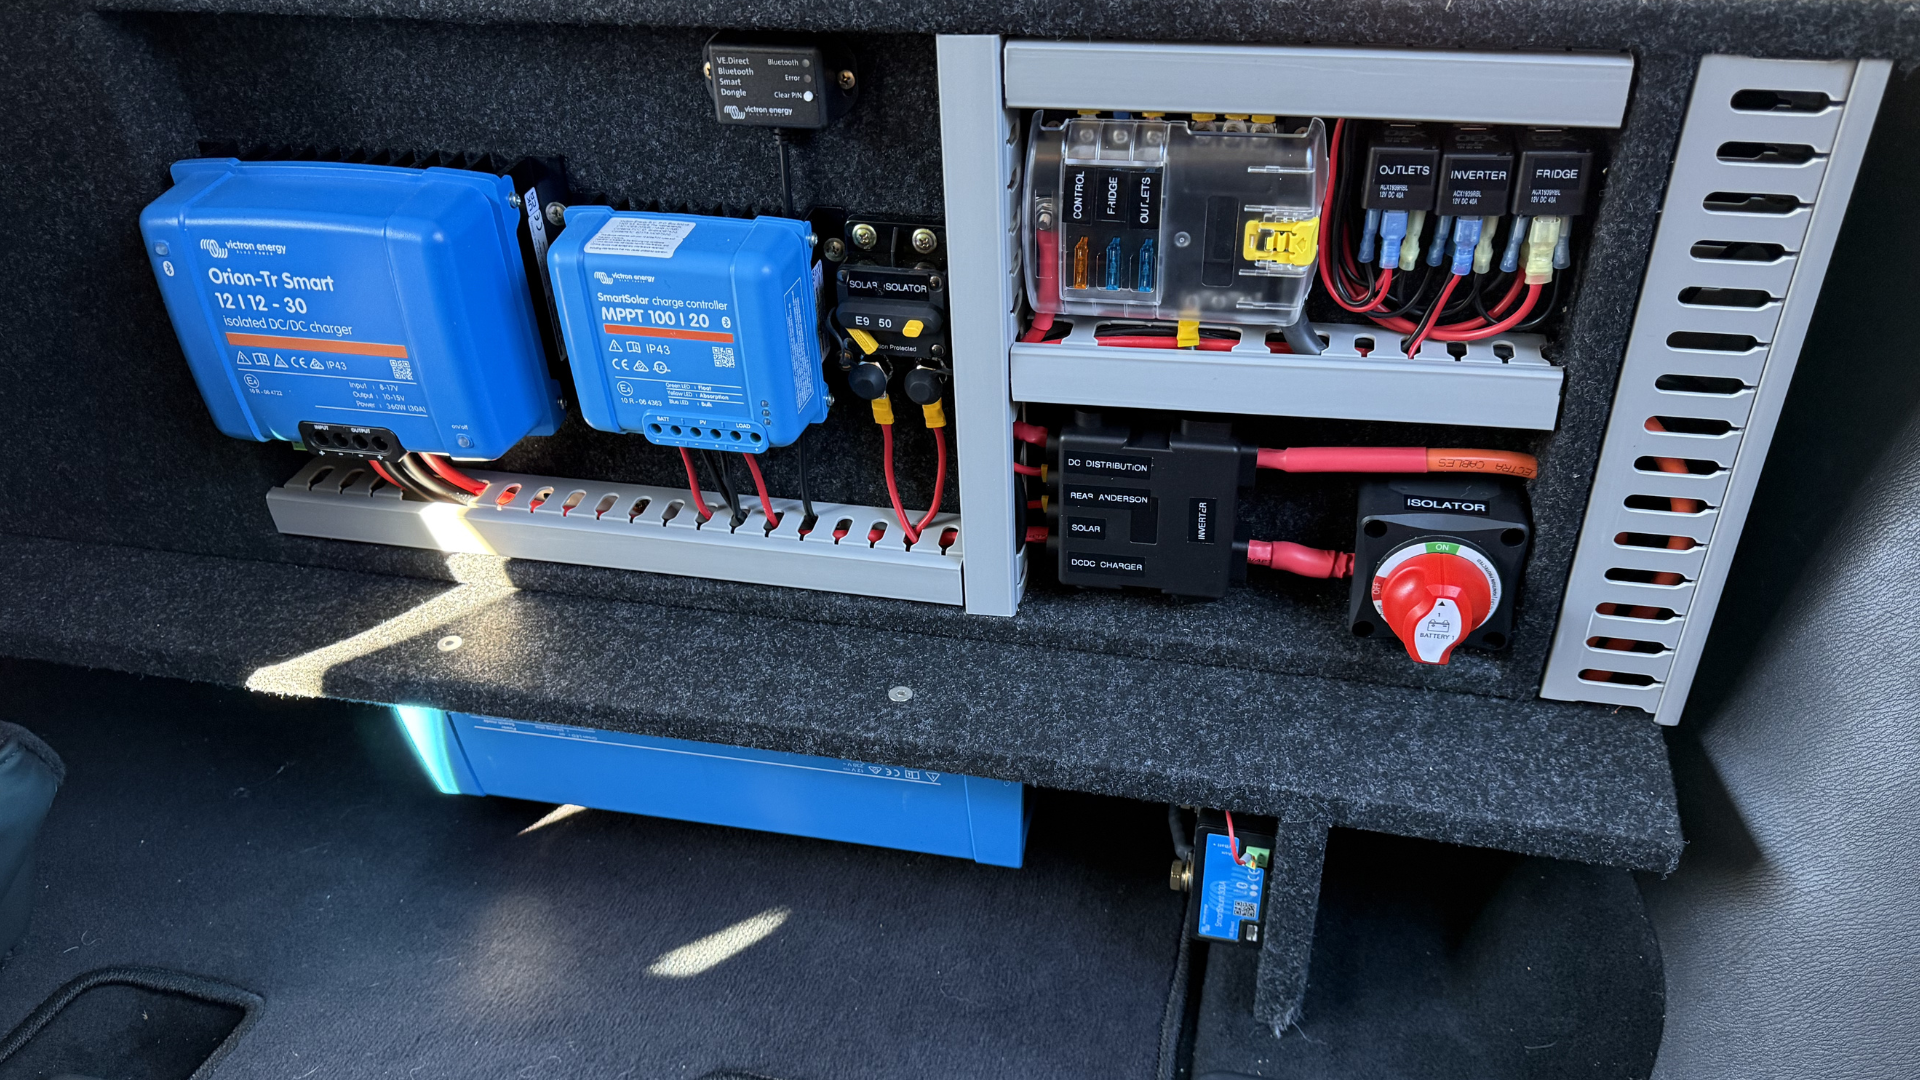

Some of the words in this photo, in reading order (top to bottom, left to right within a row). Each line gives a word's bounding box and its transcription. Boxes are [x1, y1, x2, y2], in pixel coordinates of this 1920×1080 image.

[716, 57, 750, 65] VE.Direct
[718, 68, 754, 76] Bluetooth
[720, 88, 747, 98] Dongle
[1379, 165, 1430, 175] OUTLETS
[1450, 170, 1507, 180] INVERTER
[1536, 169, 1578, 179] FRIDGE
[1073, 171, 1085, 220] CONTROL
[1106, 176, 1118, 214] FRIDGE
[225, 240, 255, 250] victron
[256, 243, 286, 255] energy
[208, 267, 278, 288] Orion-Tr
[282, 272, 334, 292] Smart
[849, 280, 878, 289] SOLAR
[215, 292, 236, 309] 12
[247, 295, 268, 311] 12
[284, 297, 307, 314] 30
[597, 292, 649, 305] SmartSolar
[652, 296, 684, 309] charge
[686, 299, 728, 311] controller
[601, 306, 644, 323] MPPT
[648, 310, 676, 326] 100
[688, 314, 710, 328] 20
[855, 316, 870, 326] E9
[878, 318, 892, 328] 50
[222, 315, 267, 329] isolated
[268, 318, 307, 332] DC/DC
[310, 321, 352, 337] charger
[646, 343, 671, 355] IP43
[325, 360, 347, 371] IP43
[352, 391, 373, 399] Output
[1068, 459, 1081, 467] DC
[1085, 460, 1148, 472] DISTRIBUTION
[1438, 458, 1485, 469] CABLES
[1098, 494, 1148, 504] ANDERSON
[1407, 498, 1486, 512] ISOLATOR
[1198, 502, 1207, 540] INVERTER
[1072, 524, 1100, 533] SOLAR
[1071, 559, 1096, 568] DCDC
[1100, 561, 1143, 571] CHARGER
[1420, 632, 1450, 640] BATTERY
[1214, 896, 1225, 927] SmartShunt
